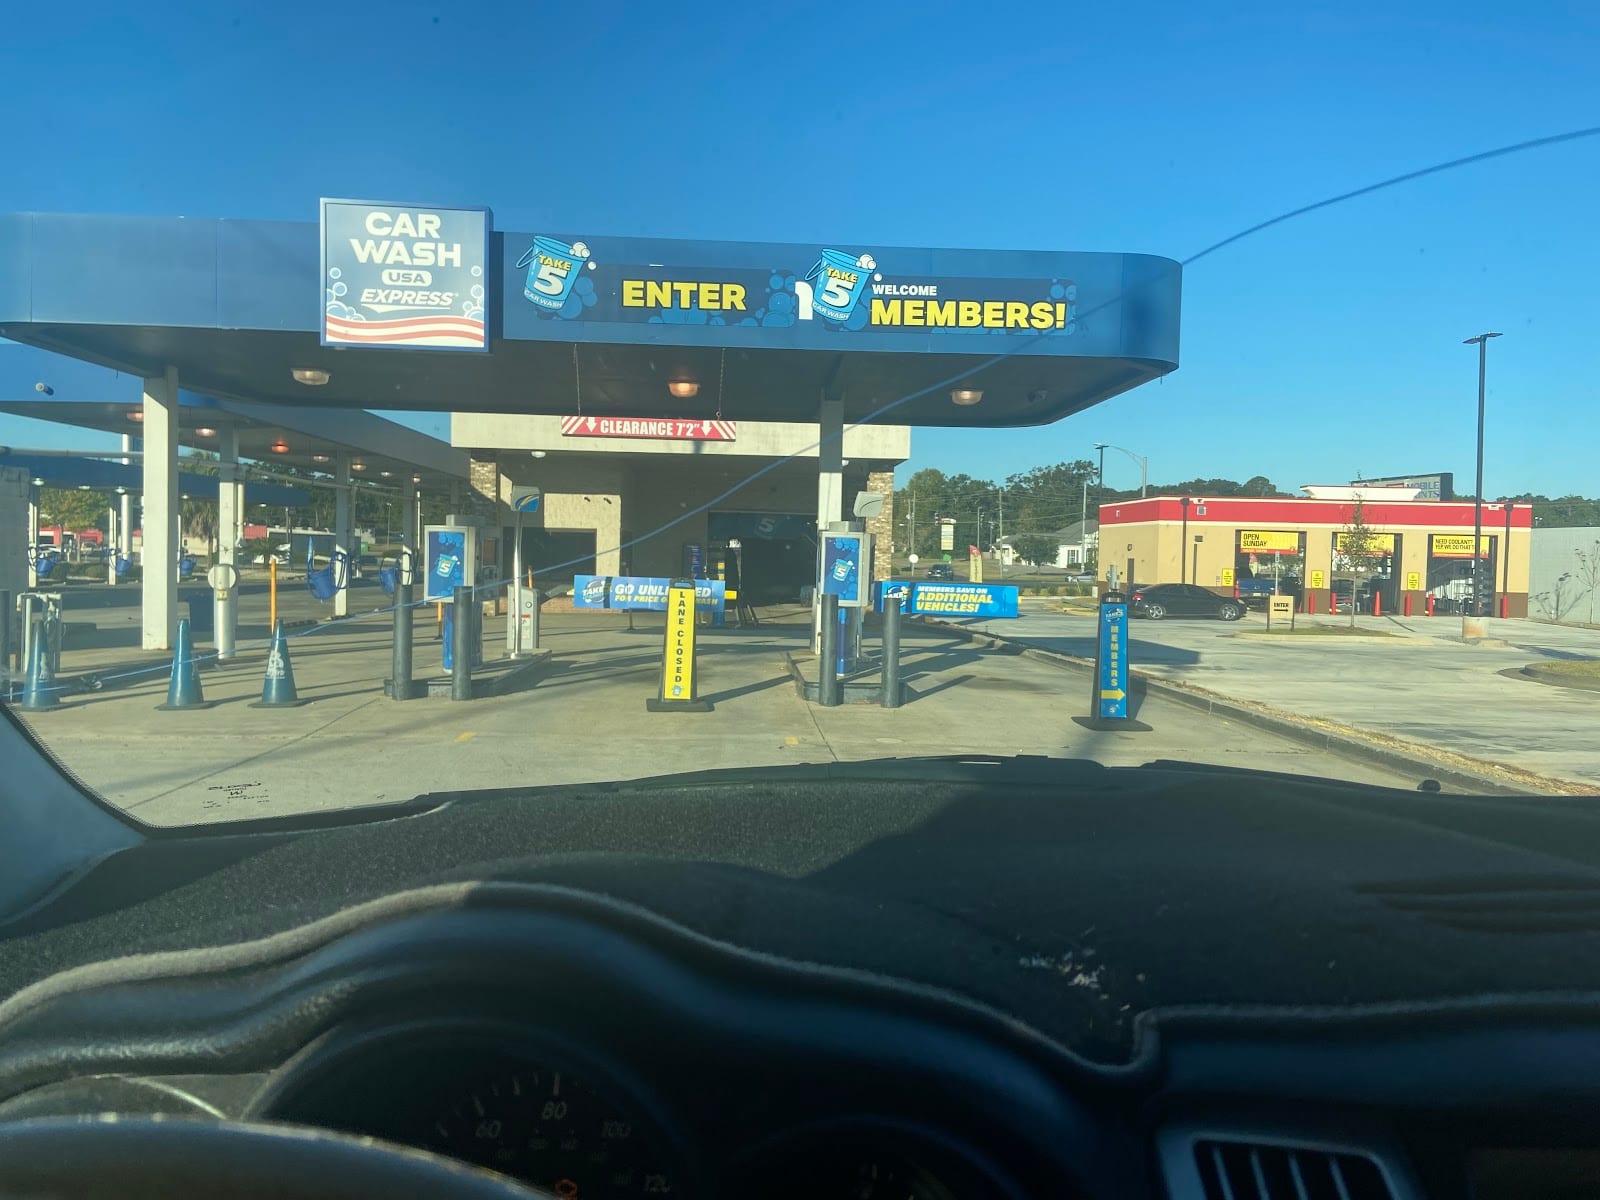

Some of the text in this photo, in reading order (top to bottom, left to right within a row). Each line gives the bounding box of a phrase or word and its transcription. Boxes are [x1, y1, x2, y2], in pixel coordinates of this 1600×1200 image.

[365, 211, 441, 239] CAR
[349, 238, 462, 267] WASH
[539, 254, 572, 272] TAKE
[388, 272, 425, 284] USA
[533, 264, 569, 297] 5
[826, 267, 859, 285] TAKE
[360, 288, 454, 306] EXPRESS
[622, 279, 747, 311] ENTER
[820, 277, 856, 309] 5
[872, 284, 938, 296] WELCOME
[870, 298, 1067, 329] MEMBERS!
[600, 419, 700, 437] CLEARANCE 7'2"
[1243, 533, 1260, 541] OPEN
[615, 584, 712, 598] GO UNLIED
[916, 592, 993, 604] ADDITIONAL
[915, 602, 980, 613] VEHICLES!
[674, 590, 686, 683] LANE CLOSED
[1110, 625, 1119, 687] MEMBERS
